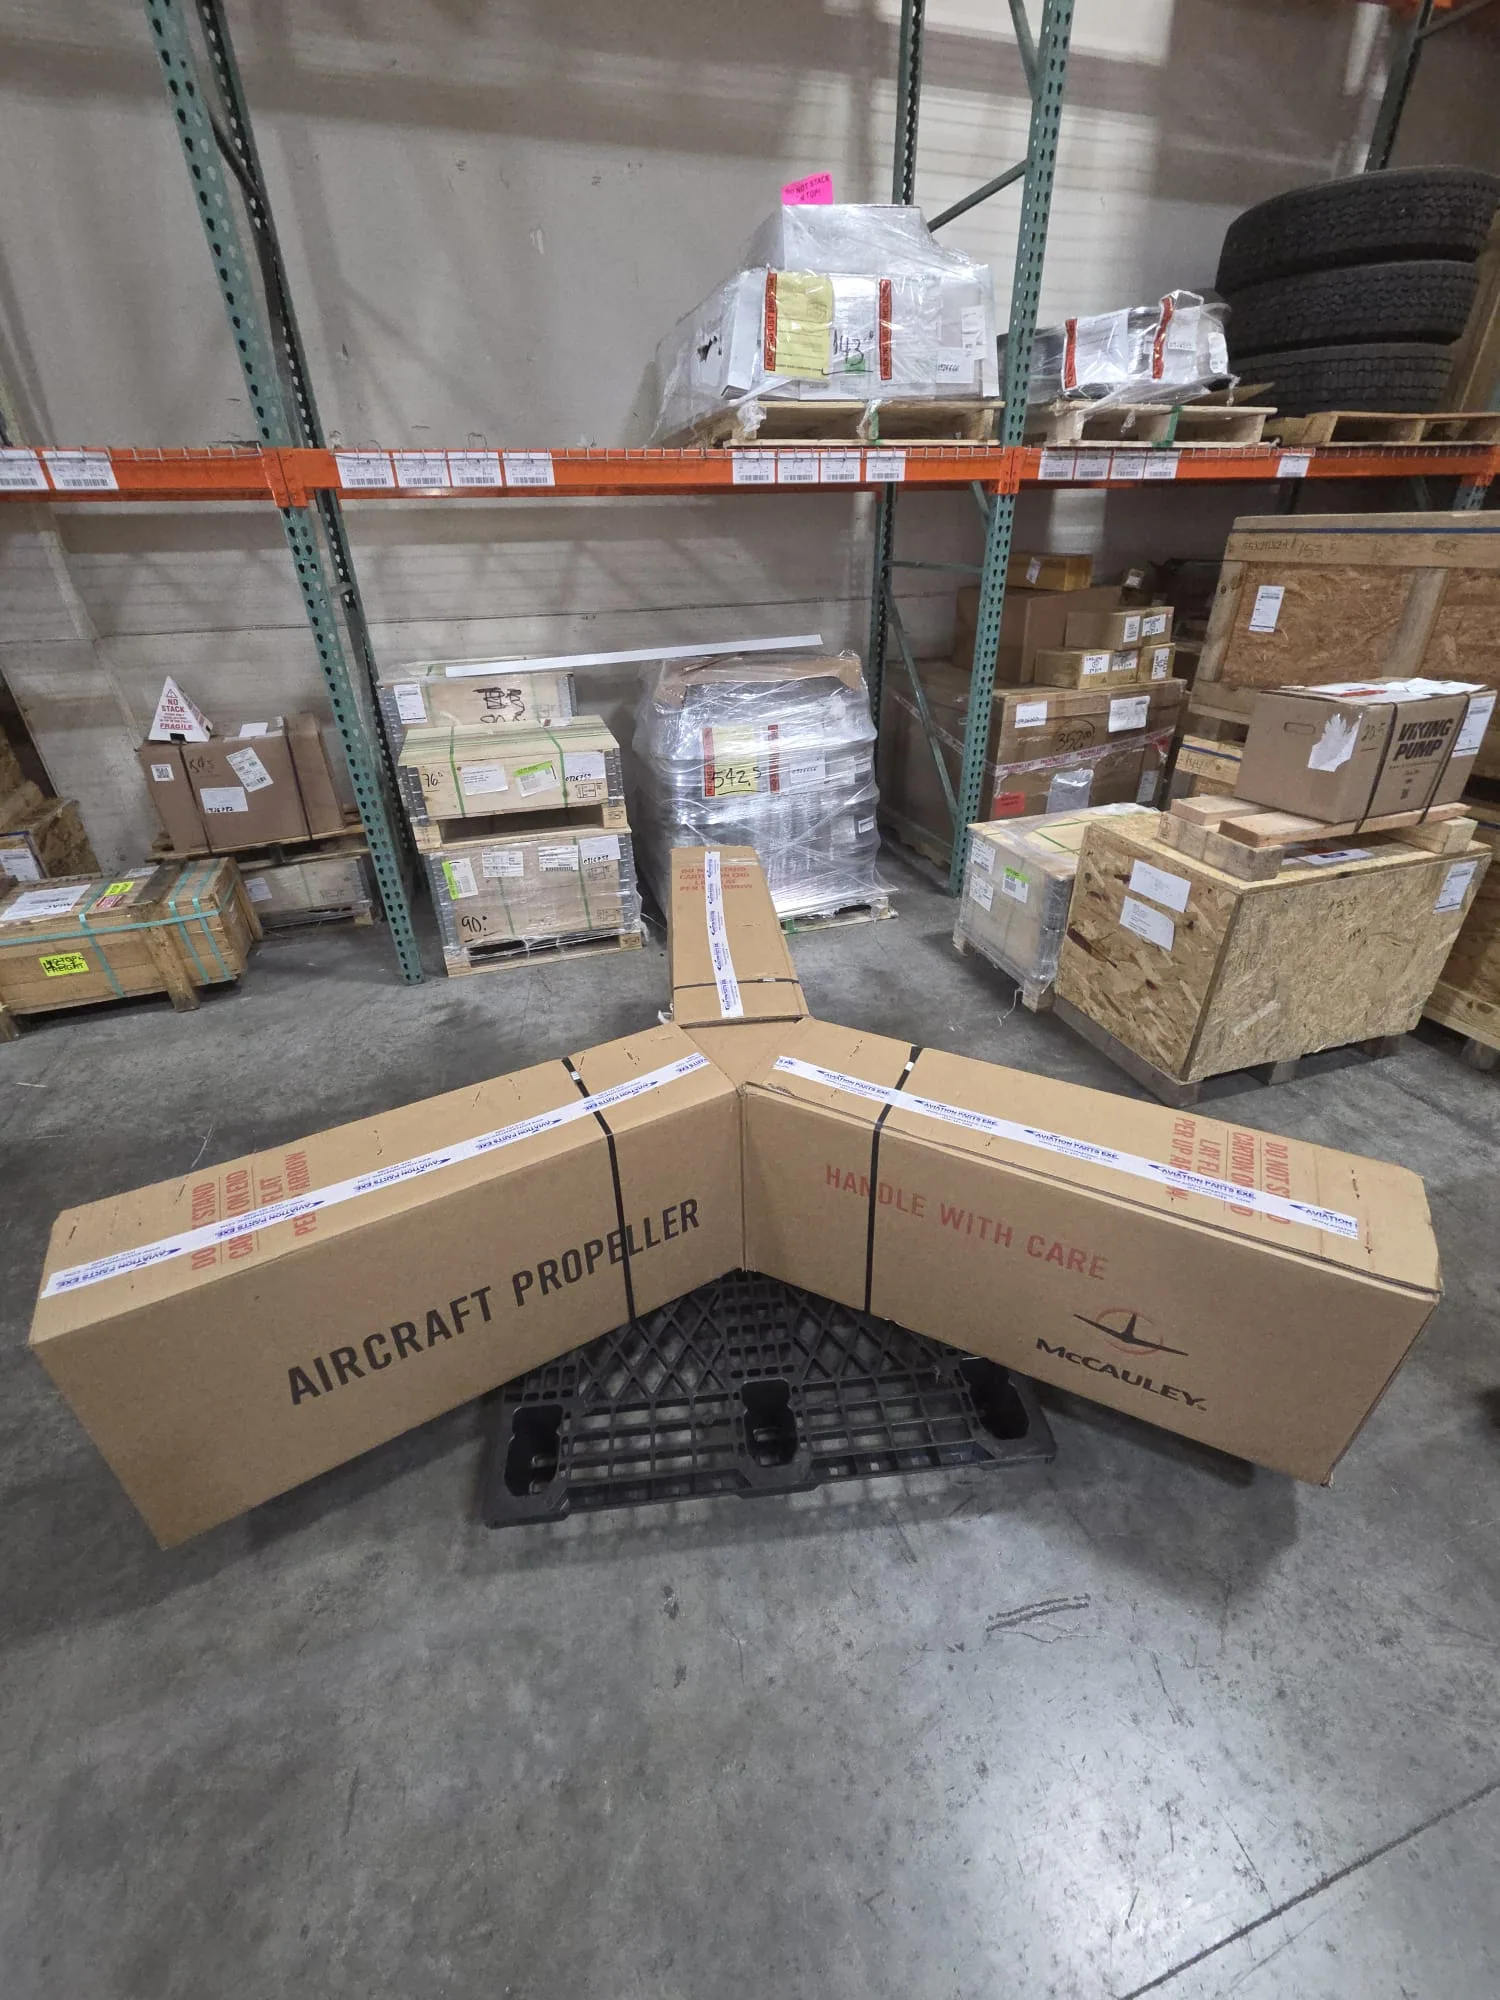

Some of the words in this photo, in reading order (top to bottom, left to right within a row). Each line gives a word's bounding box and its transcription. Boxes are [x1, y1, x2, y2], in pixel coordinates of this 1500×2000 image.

[161, 705, 185, 713] STACK
[167, 698, 179, 706] NO
[160, 722, 193, 731] FRAGILE
[1398, 718, 1454, 742] VIKING
[1393, 739, 1444, 761] PUMP
[924, 1103, 957, 1115] AVIATION
[518, 1119, 551, 1136] AVIATION
[1173, 1116, 1196, 1139] PER
[493, 1132, 518, 1144] PARTS
[1035, 1132, 1074, 1148] AVIATION
[1074, 1143, 1101, 1155] PARTS
[1171, 1138, 1194, 1156] UP
[1197, 1138, 1222, 1161] LAY
[1230, 1131, 1255, 1174] CARTON
[1265, 1142, 1289, 1159] DO
[401, 1159, 439, 1177] AVIATION
[1265, 1158, 1291, 1185] NOT
[373, 1172, 400, 1186] PARTS
[1160, 1167, 1204, 1186] AVIATION
[1204, 1179, 1236, 1194] PARTS
[191, 1182, 217, 1222] STAND
[267, 1202, 312, 1222] AVIATION
[236, 1216, 268, 1231] PARTS
[826, 1165, 928, 1218] HANDLE
[940, 1203, 1013, 1248] WITH
[1026, 1234, 1109, 1282] CARE
[1305, 1207, 1353, 1228] AVIATION
[117, 1249, 168, 1269] AVIATION
[191, 1247, 217, 1271] DO
[81, 1265, 117, 1281] PARTS
[287, 1286, 493, 1405] AIRCRAFT
[511, 1199, 700, 1307] PROPELLER
